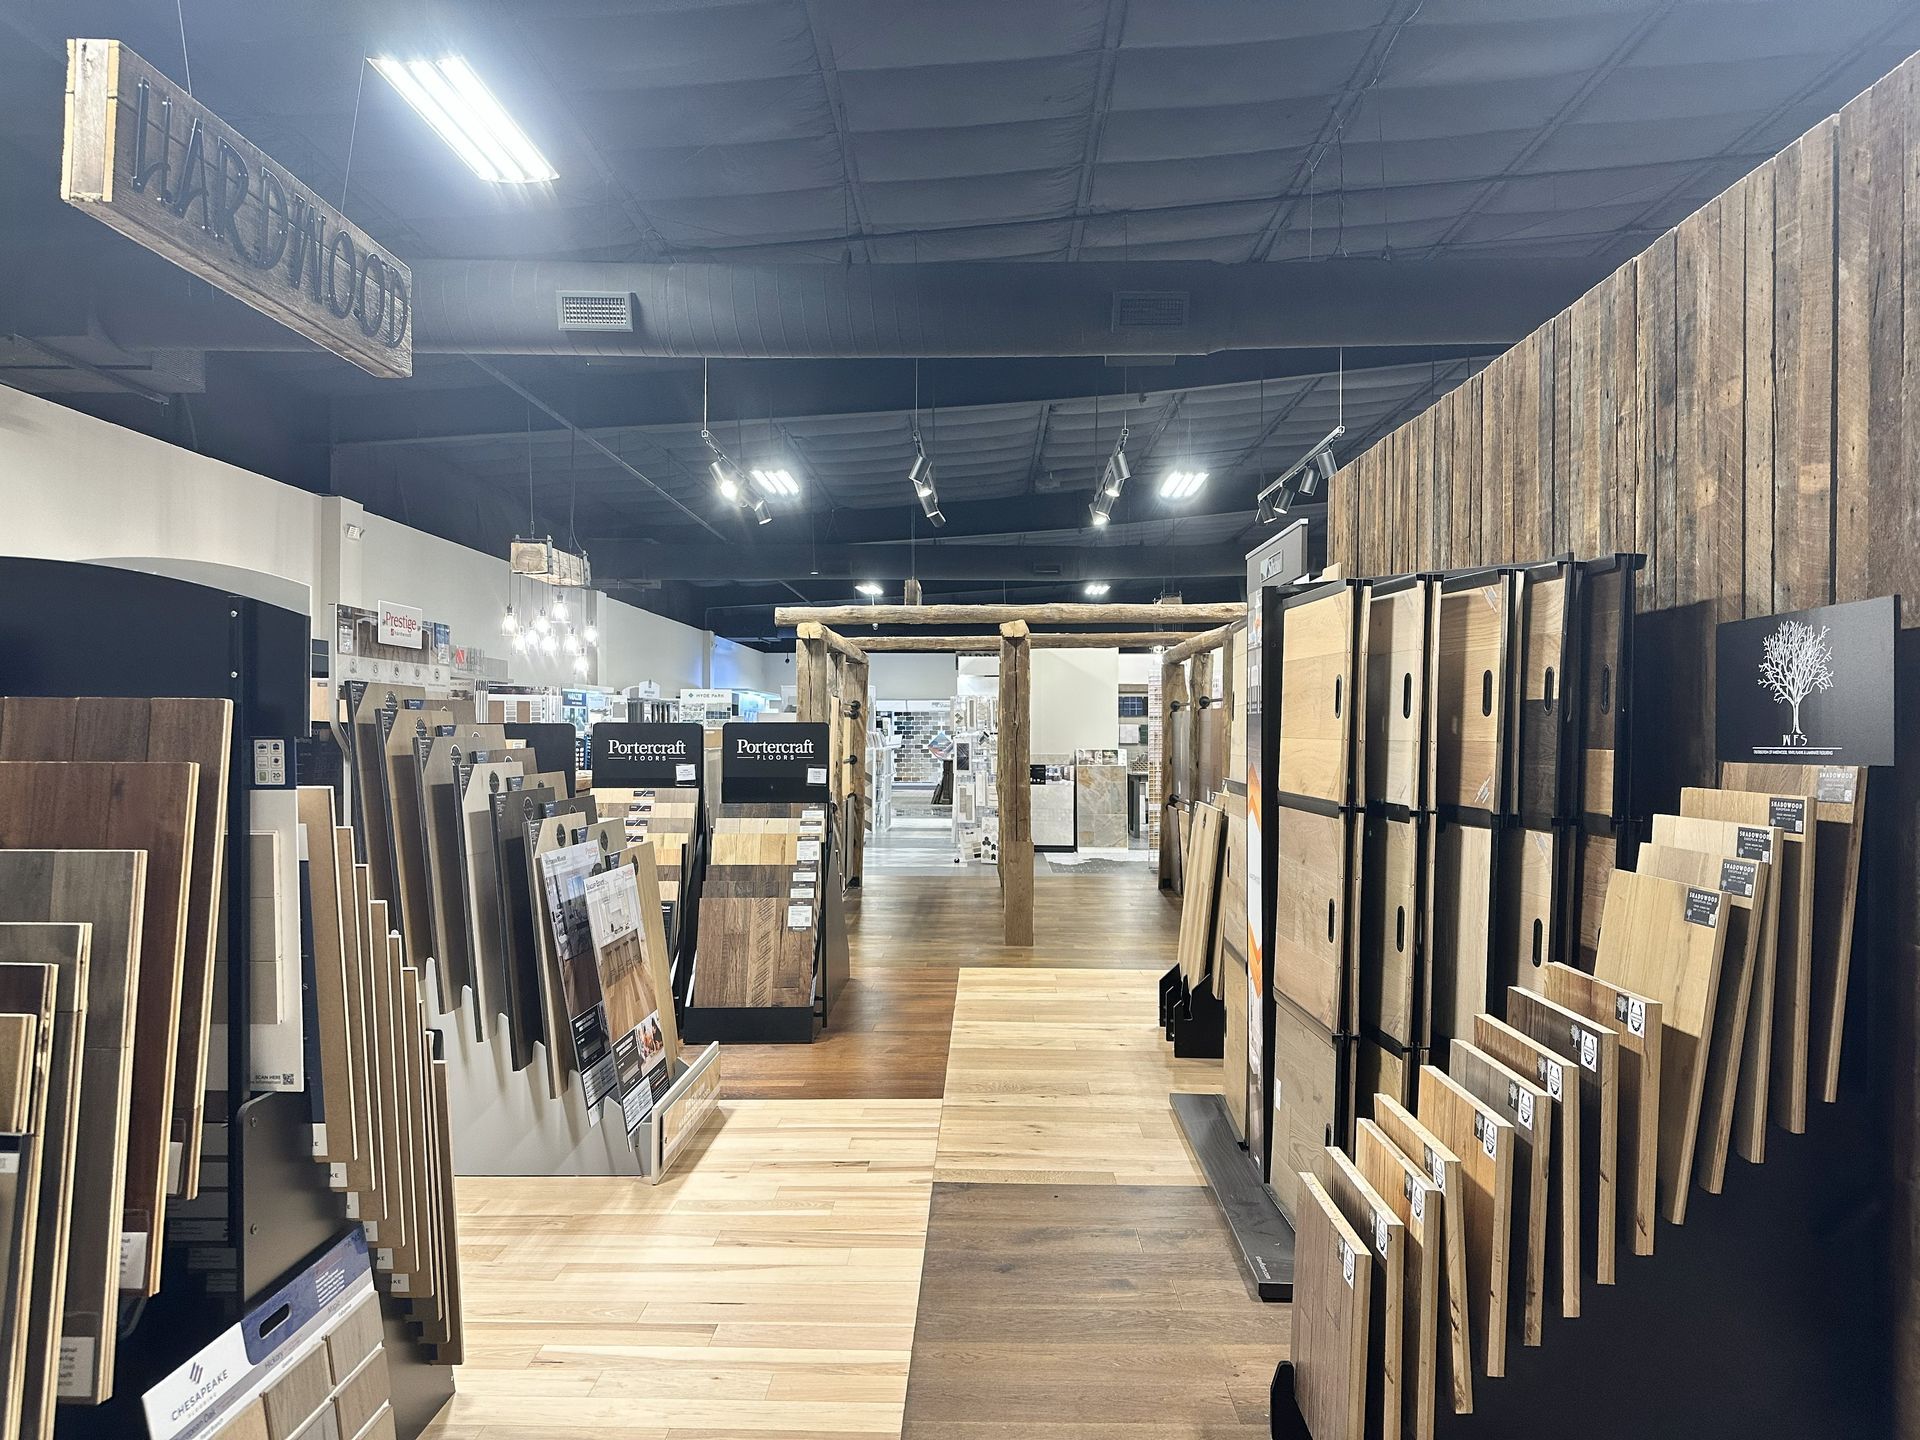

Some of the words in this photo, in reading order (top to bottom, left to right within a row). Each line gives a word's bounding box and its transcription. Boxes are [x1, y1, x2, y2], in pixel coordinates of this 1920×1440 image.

[130, 76, 409, 348] HARDWOOD
[385, 611, 417, 632] Prestige
[608, 739, 687, 755] Portercraft
[736, 738, 815, 754] Portercraft
[1771, 800, 1803, 809] SHADOWOOD
[1723, 862, 1754, 873] SHADOWOOD
[1689, 891, 1718, 903] SHADOWOOD
[171, 1368, 229, 1421] CHESAPEAKE
